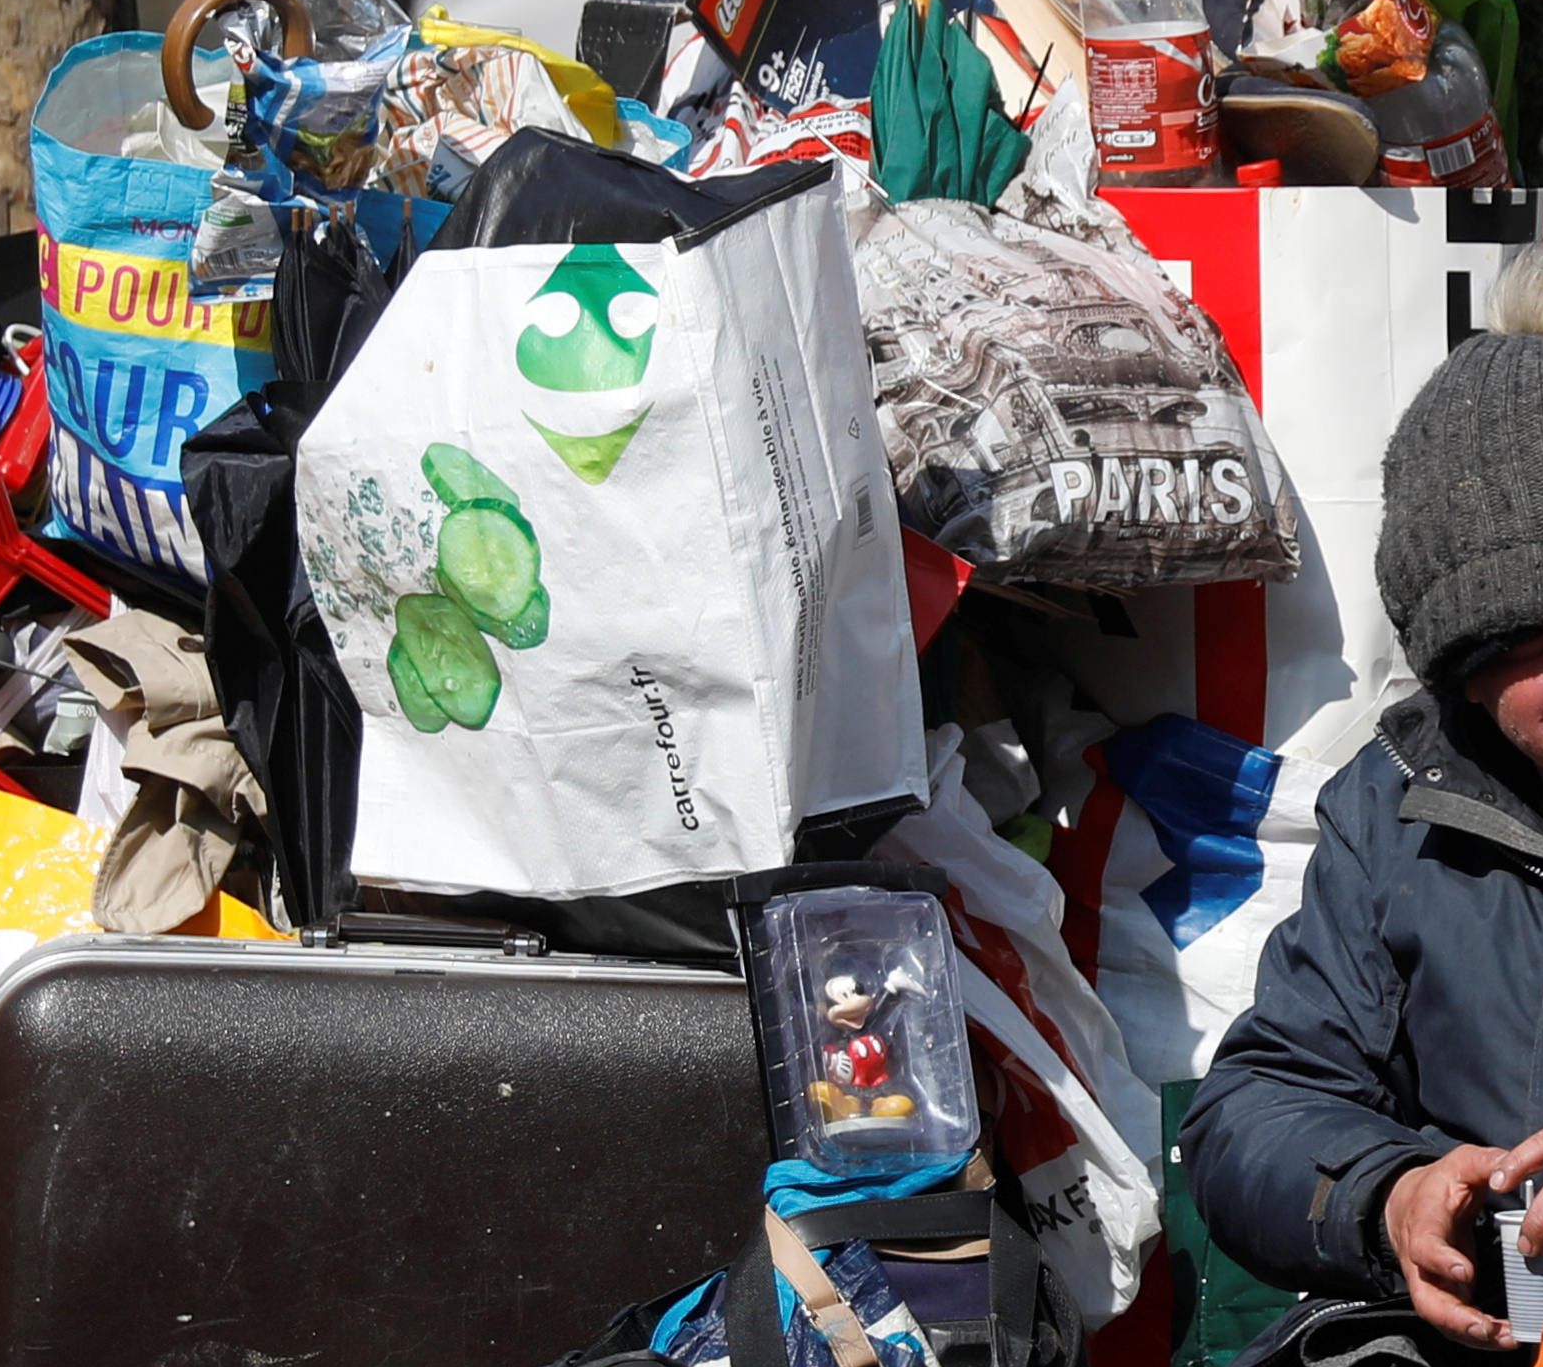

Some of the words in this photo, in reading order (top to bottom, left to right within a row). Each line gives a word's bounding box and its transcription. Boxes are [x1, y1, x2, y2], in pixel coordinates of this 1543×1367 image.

[758, 49, 786, 92] 9+
[783, 56, 807, 104] 75257
[750, 371, 766, 407] vie.
[755, 409, 770, 425] à
[762, 427, 798, 547] échangeable
[1048, 456, 1255, 525] PARIS
[630, 665, 700, 832] carrefour.fr
